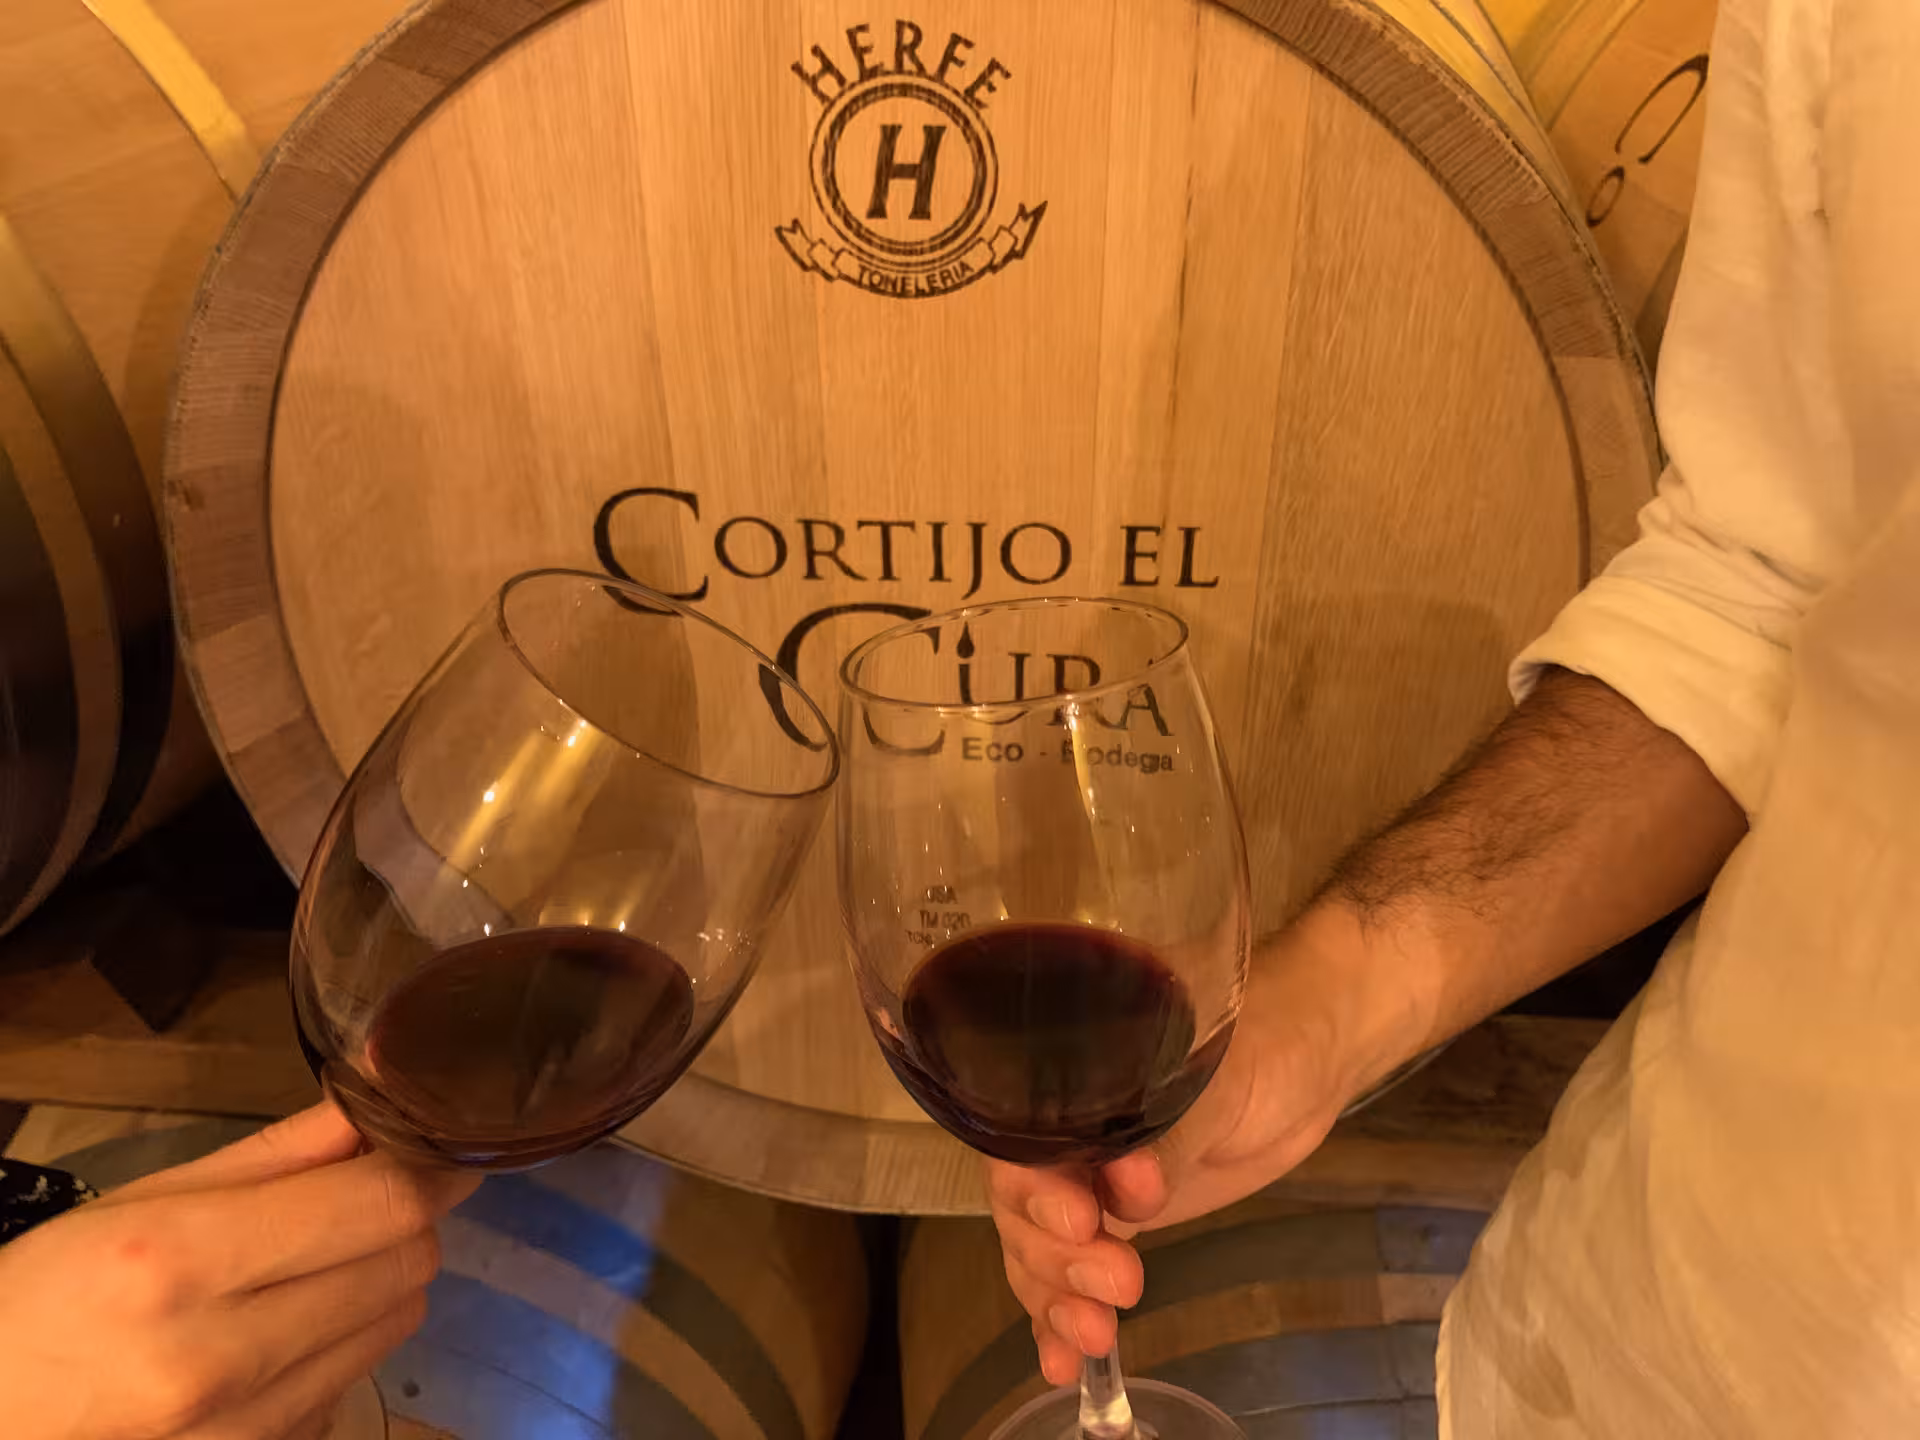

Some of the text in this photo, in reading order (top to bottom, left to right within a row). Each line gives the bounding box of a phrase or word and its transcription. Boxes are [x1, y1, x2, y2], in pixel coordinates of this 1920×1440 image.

[790, 19, 1011, 109] HERFE
[866, 124, 946, 220] H
[858, 262, 974, 293] TONELERIA
[1119, 525, 1220, 588] EL
[961, 737, 1024, 762] Eco
